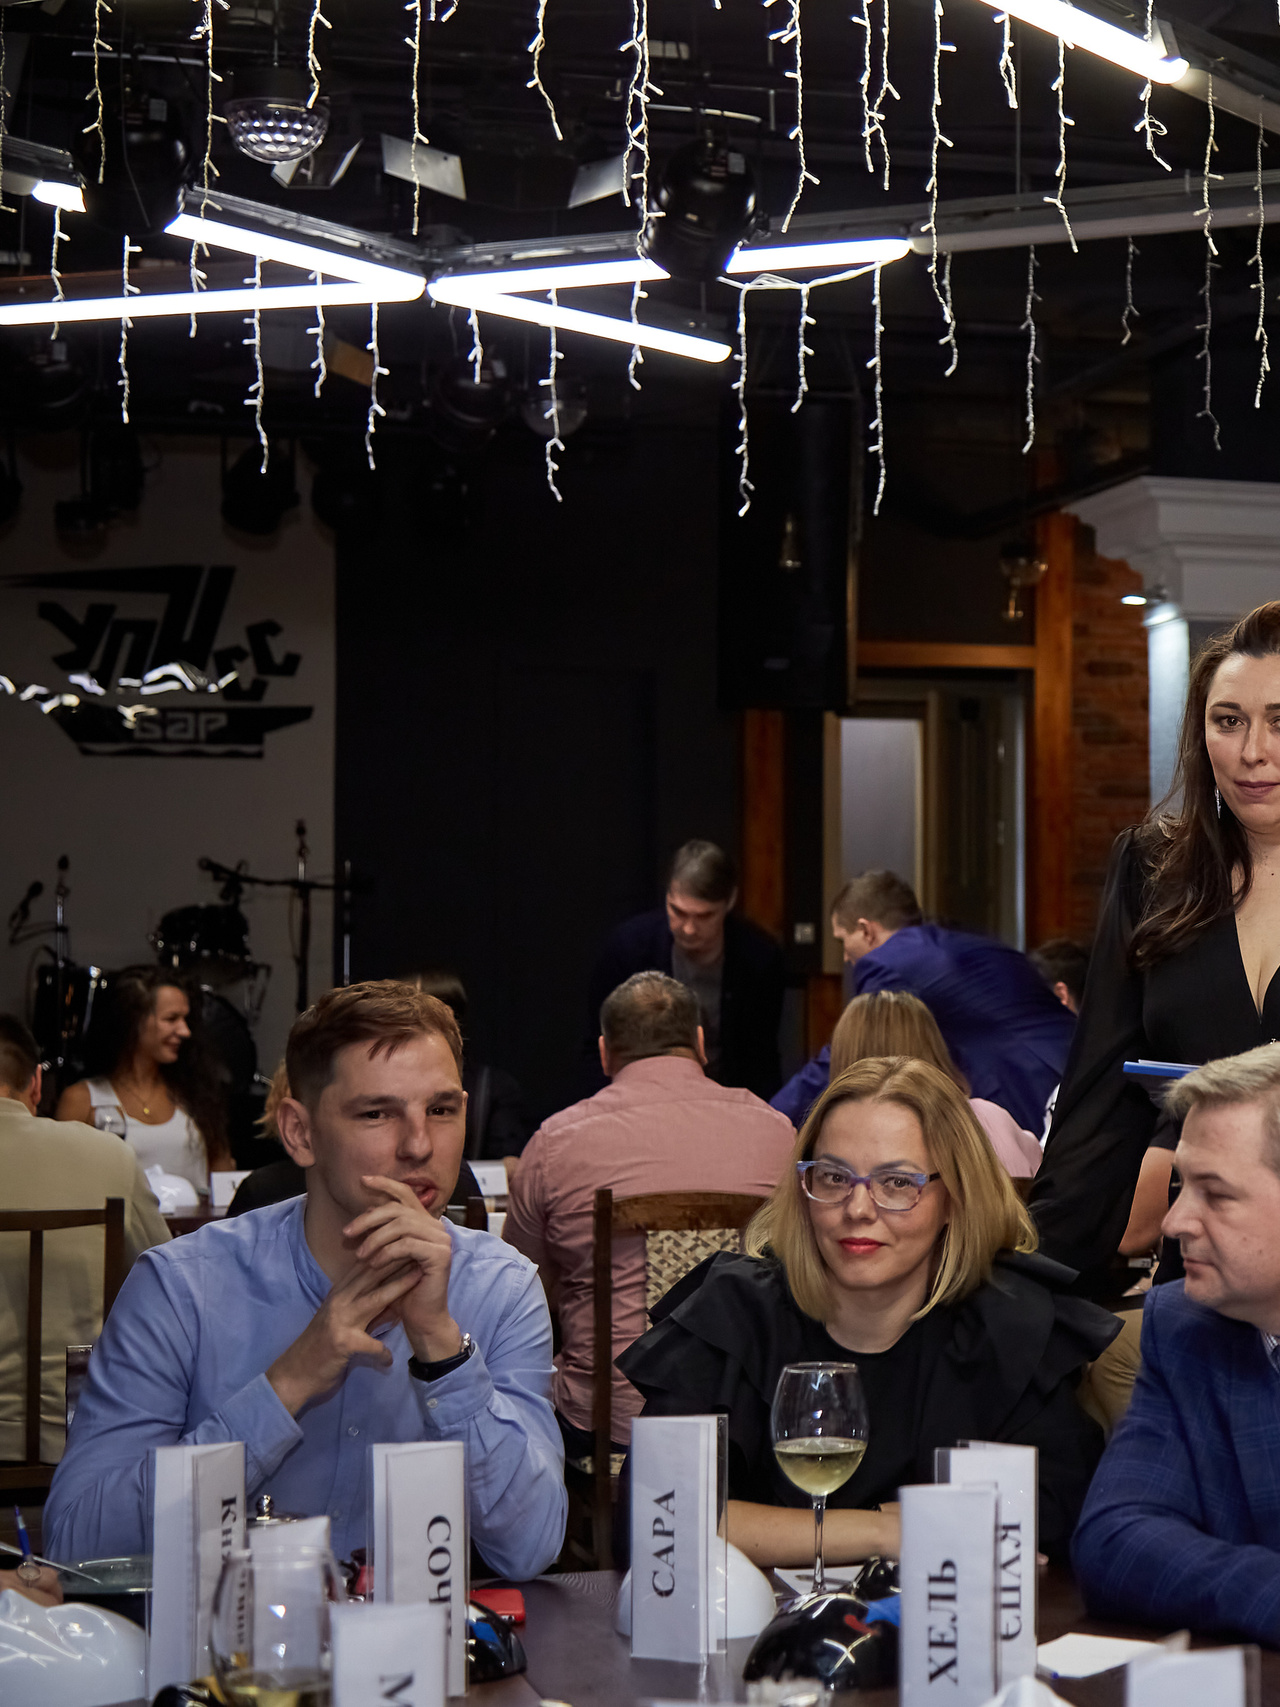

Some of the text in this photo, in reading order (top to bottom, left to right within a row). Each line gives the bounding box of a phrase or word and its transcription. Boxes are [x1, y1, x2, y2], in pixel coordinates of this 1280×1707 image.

[427, 1514, 452, 1640] СОЧ
[652, 1489, 675, 1599] САРА
[927, 1559, 958, 1685] ХЕЛЬ
